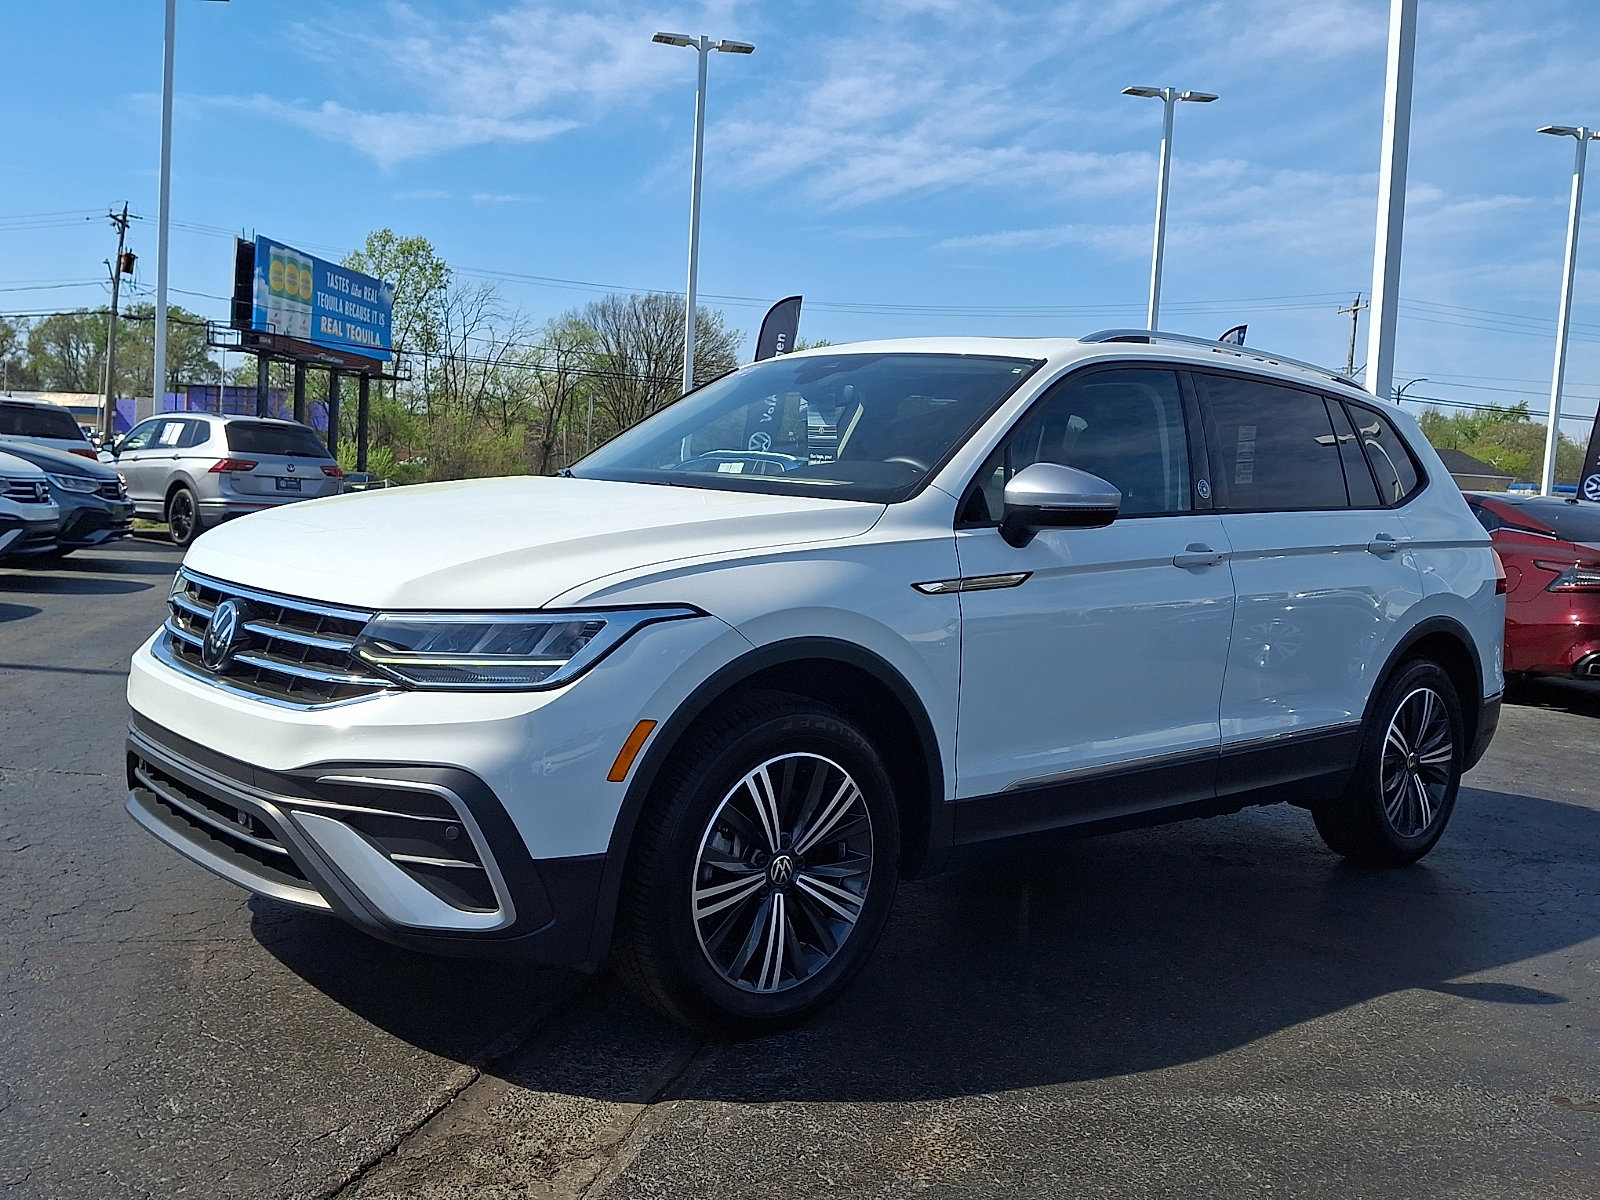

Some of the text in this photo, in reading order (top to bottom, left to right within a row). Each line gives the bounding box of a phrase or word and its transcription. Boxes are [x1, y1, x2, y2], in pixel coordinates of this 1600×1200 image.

[326, 271, 350, 294] TASTES
[350, 283, 362, 298] like
[363, 285, 378, 304] REAL
[316, 290, 386, 327] TEQUILA BECAUSE IT IS
[320, 315, 343, 337] REAL
